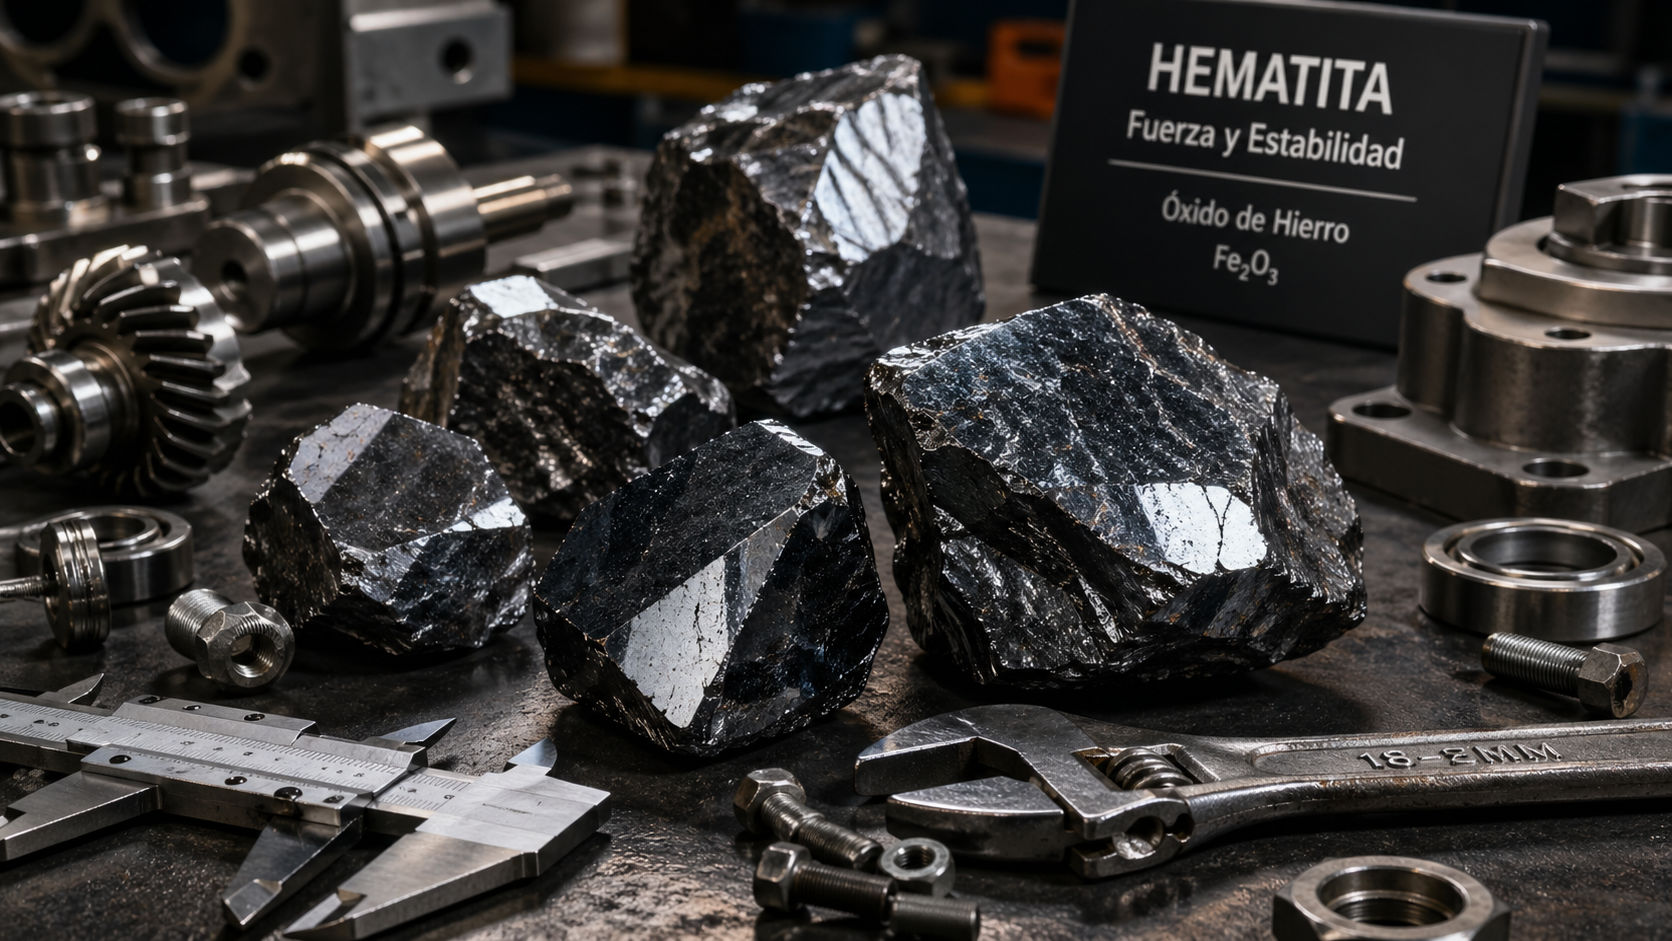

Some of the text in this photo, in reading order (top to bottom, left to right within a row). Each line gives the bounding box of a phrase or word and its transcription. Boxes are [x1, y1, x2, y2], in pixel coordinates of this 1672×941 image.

[1147, 42, 1393, 116] HEMATITA
[1127, 109, 1406, 171] Fuerza y Estabilidad
[1162, 190, 1350, 244] Óxido de Hierro
